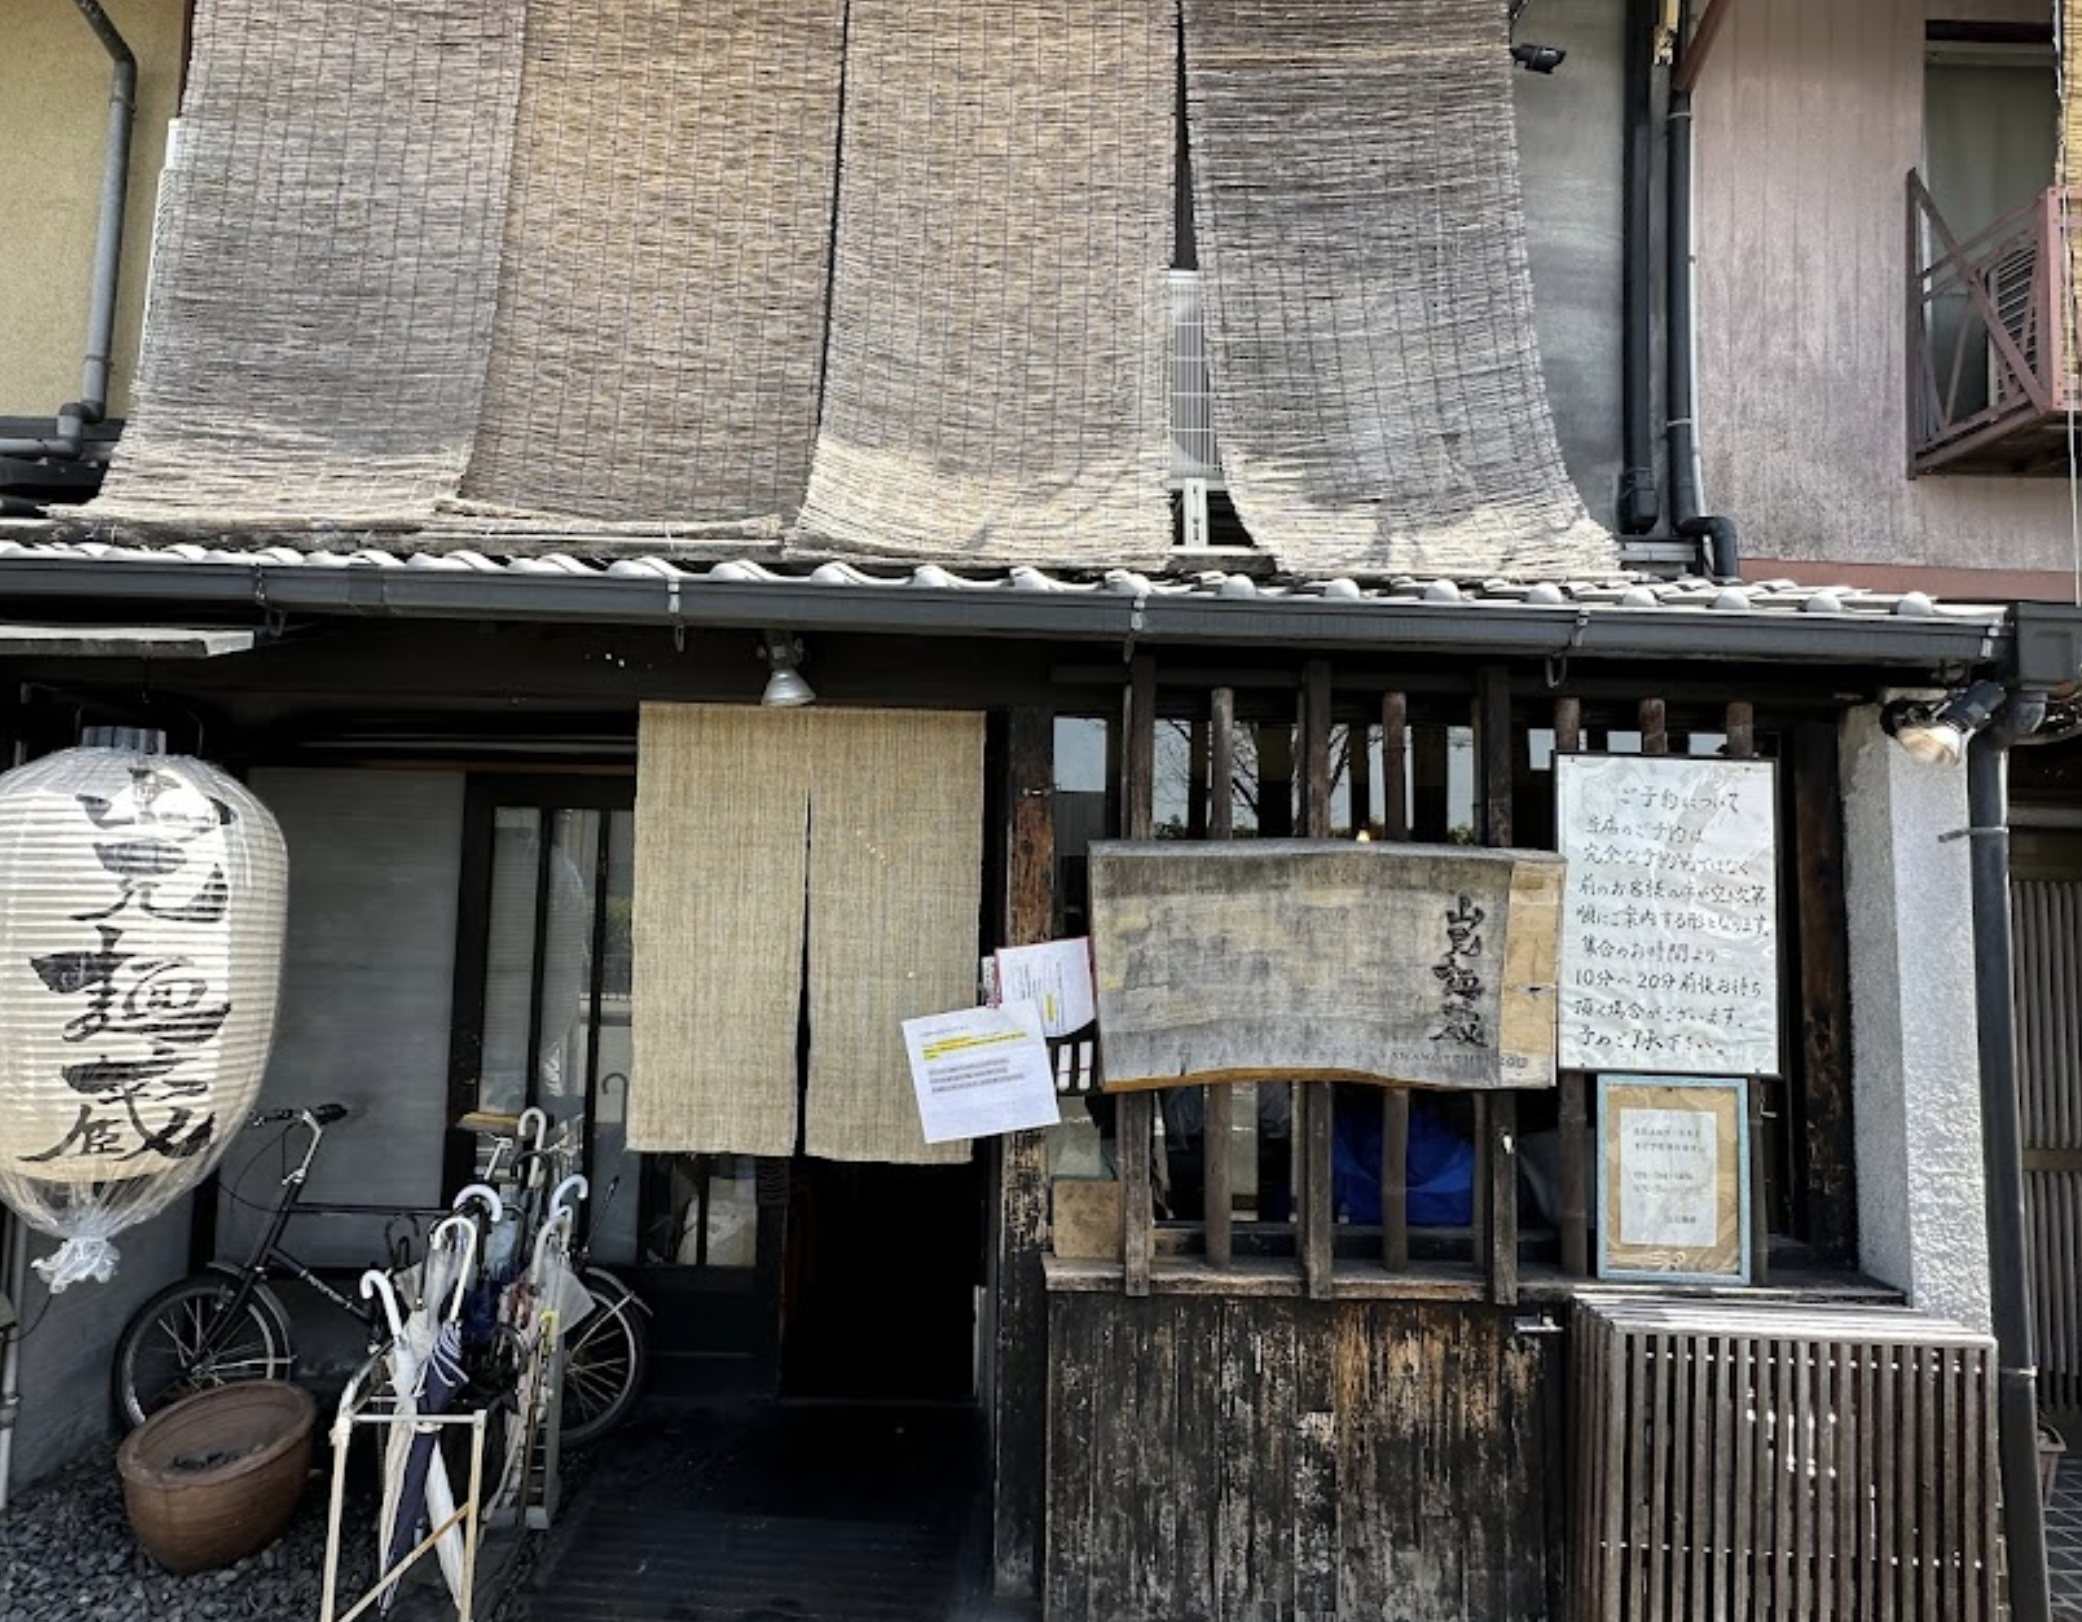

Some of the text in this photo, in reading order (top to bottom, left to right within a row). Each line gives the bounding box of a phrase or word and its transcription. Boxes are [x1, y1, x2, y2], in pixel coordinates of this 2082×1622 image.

[1618, 784, 1740, 814] ご予約について
[1585, 813, 1705, 844] 当店のご予約は
